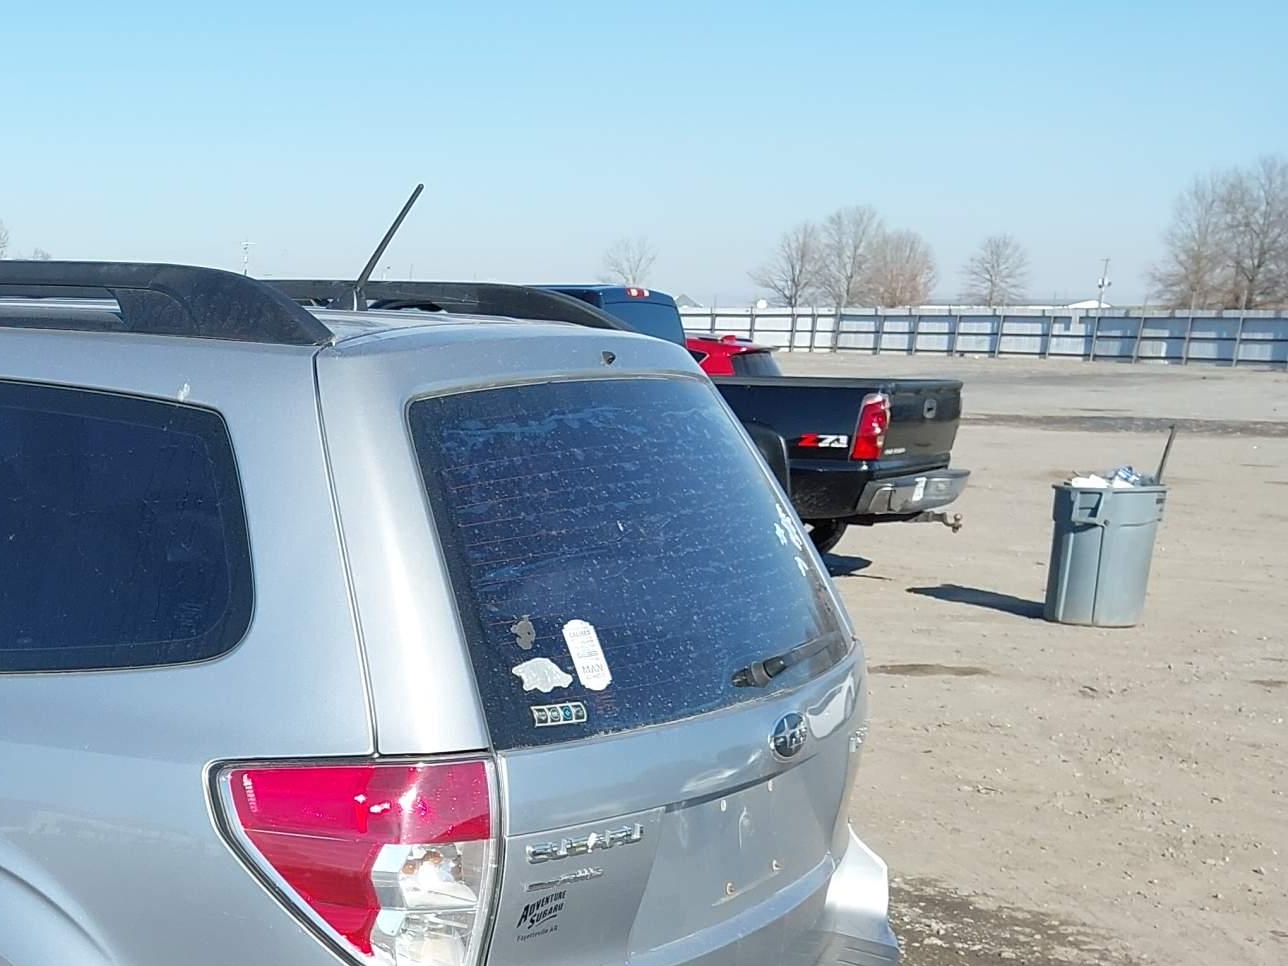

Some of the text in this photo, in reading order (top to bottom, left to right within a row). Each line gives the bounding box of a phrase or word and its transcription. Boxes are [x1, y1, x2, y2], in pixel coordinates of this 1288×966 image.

[798, 434, 849, 449] Z71
[516, 890, 567, 929] ADVENTURE
[527, 902, 565, 930] SUBARU
